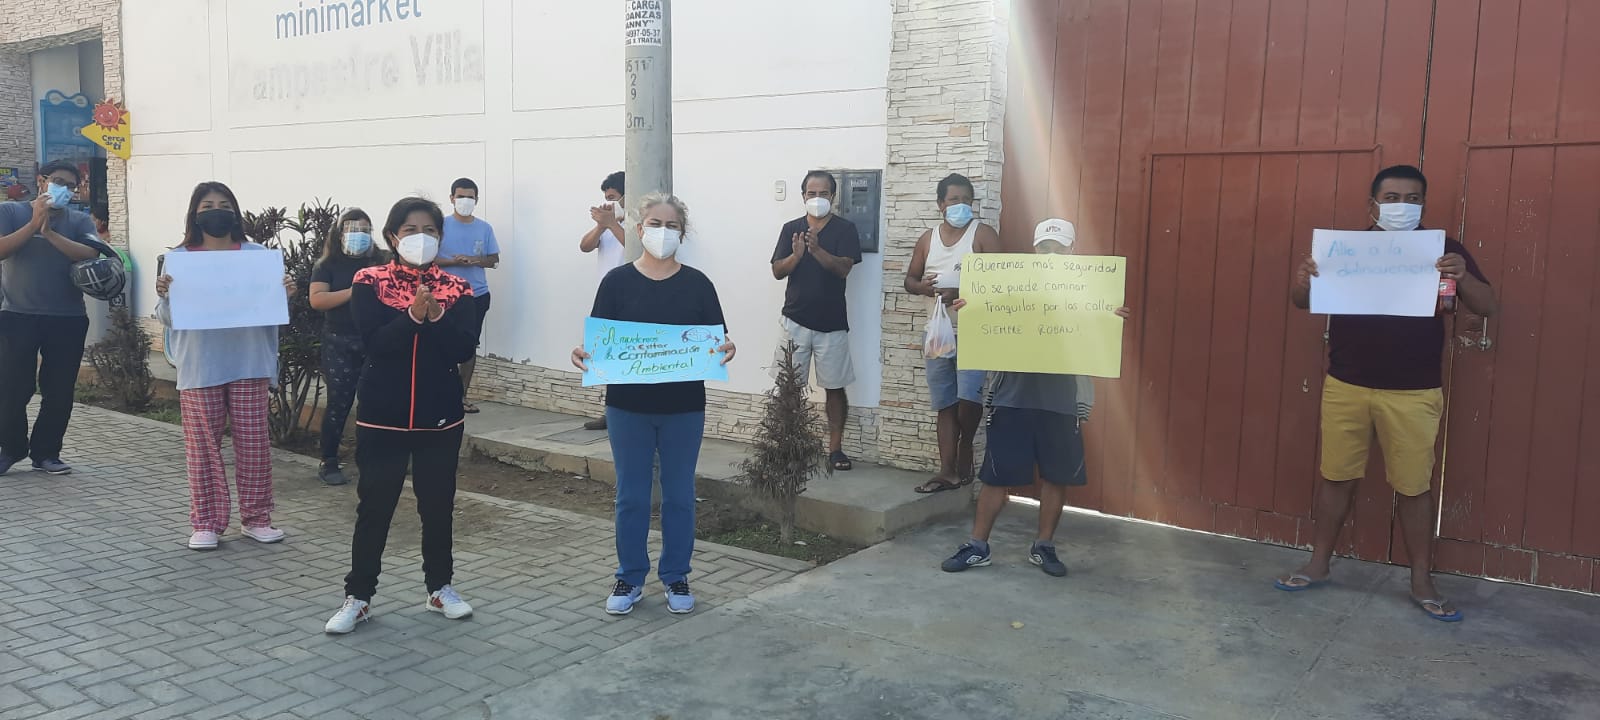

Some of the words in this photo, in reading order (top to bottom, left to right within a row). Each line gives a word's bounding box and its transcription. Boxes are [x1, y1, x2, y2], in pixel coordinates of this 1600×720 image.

[631, 0, 661, 10] CARGA
[408, 29, 482, 86] Villa
[102, 134, 125, 142] Cerca
[1063, 260, 1117, 277] seguridad
[971, 281, 986, 295] No
[991, 284, 1004, 294] se
[1007, 280, 1039, 297] puede
[1044, 281, 1087, 291] caminar
[1043, 304, 1059, 315] por
[1064, 299, 1078, 311] las
